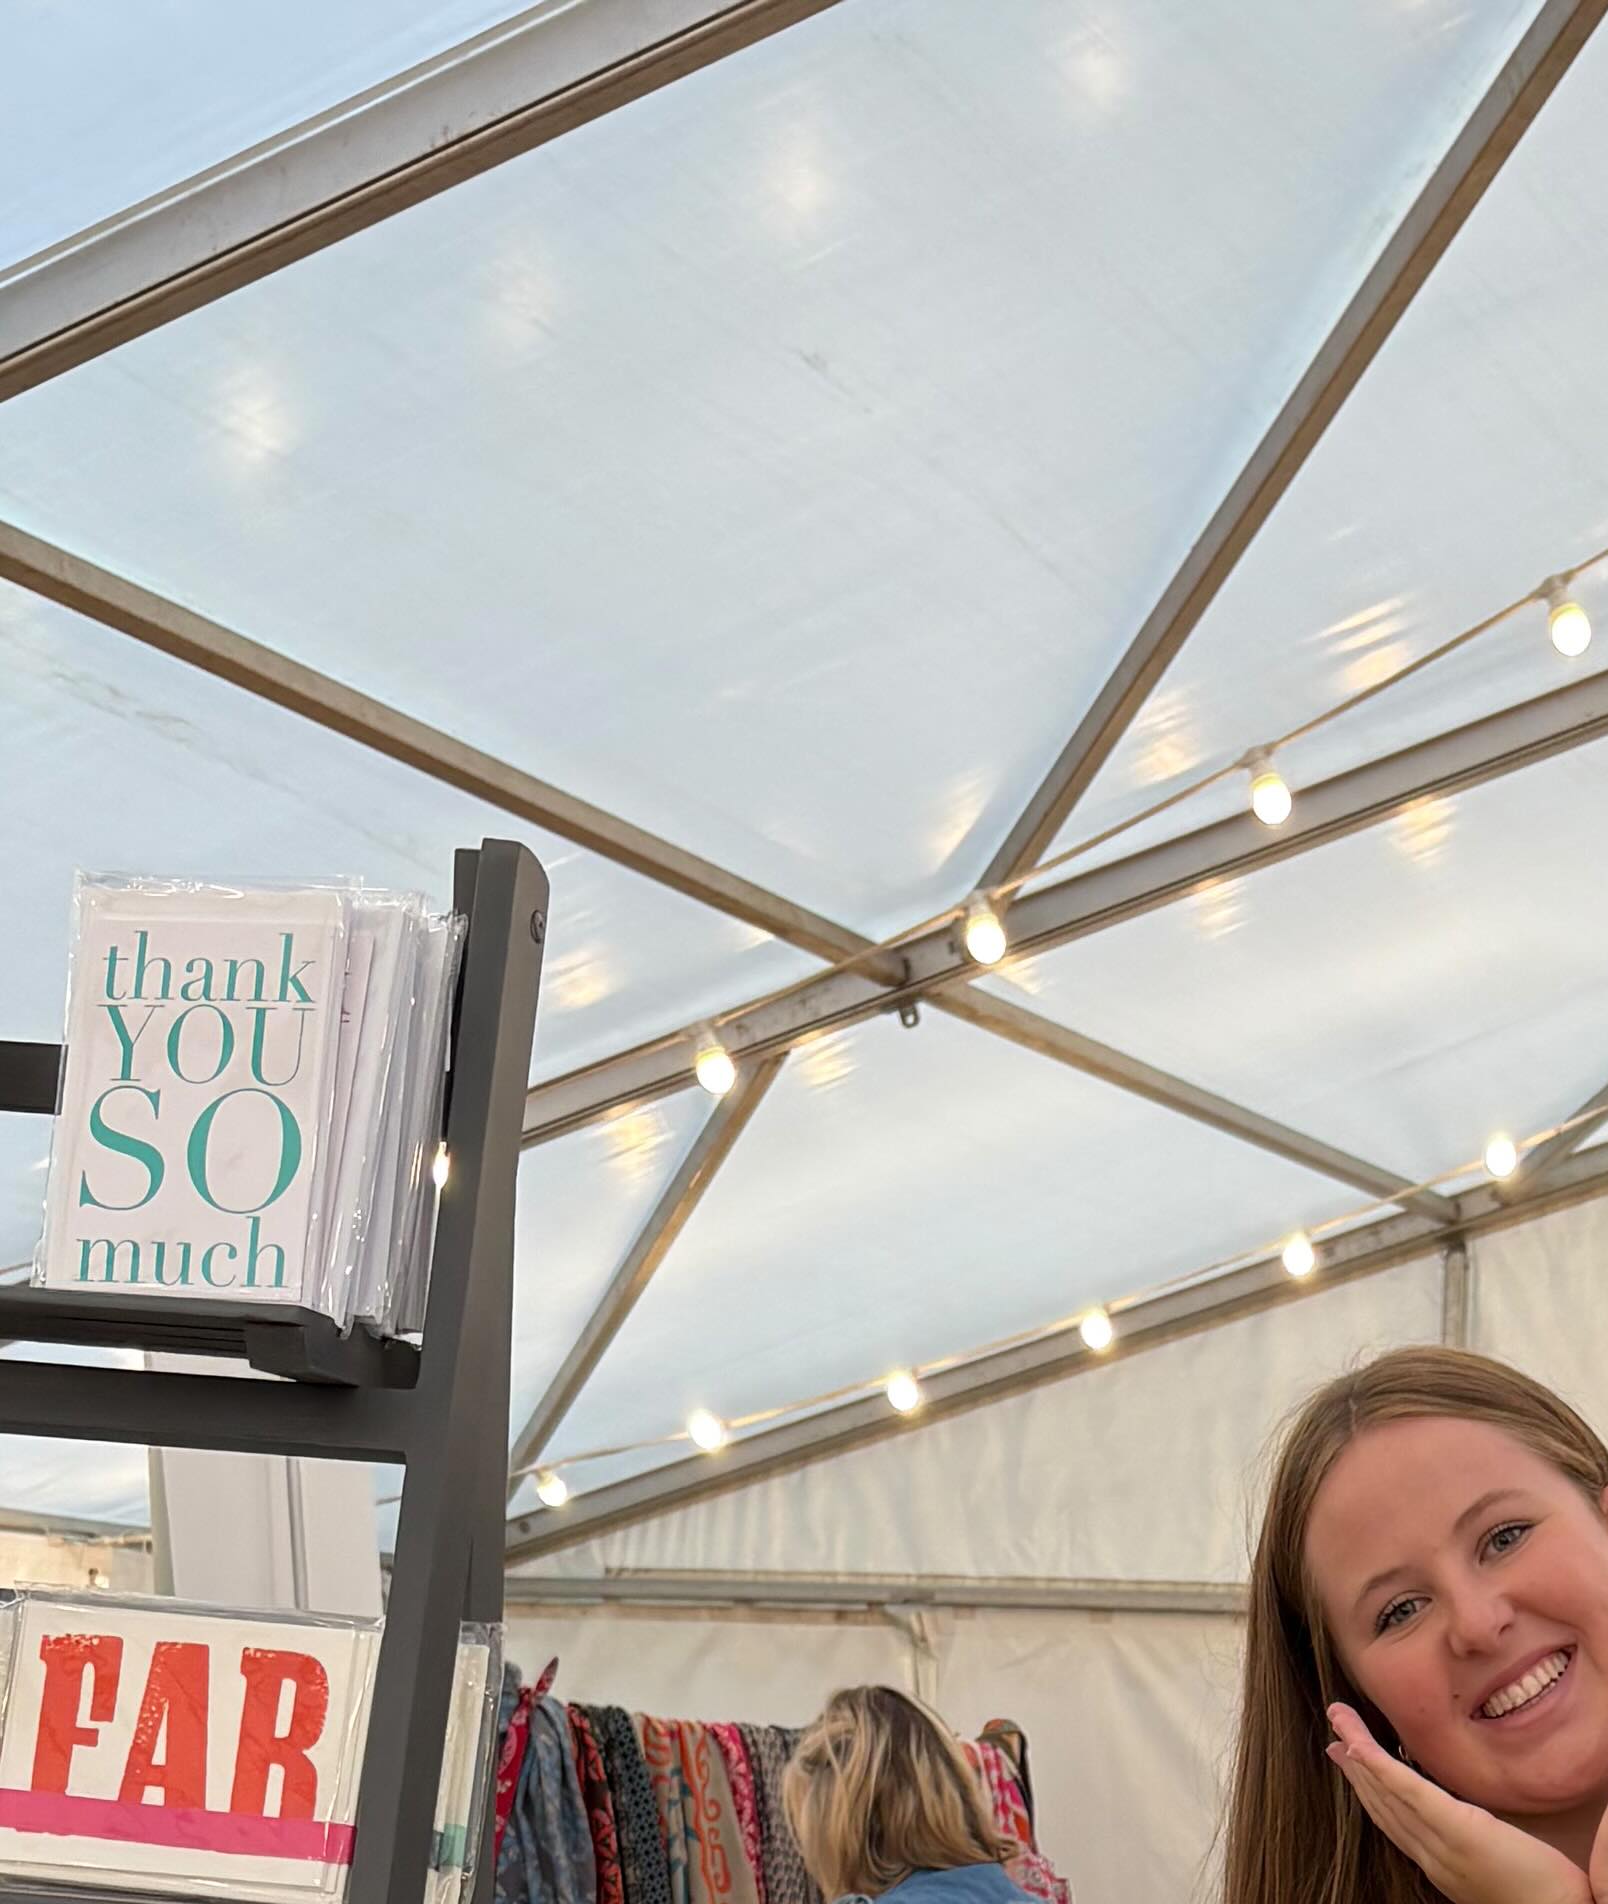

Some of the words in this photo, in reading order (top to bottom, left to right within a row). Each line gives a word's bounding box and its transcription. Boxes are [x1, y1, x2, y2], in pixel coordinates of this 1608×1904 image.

[102, 930, 317, 1003] thank
[97, 1003, 316, 1086] YOU
[79, 1085, 302, 1214] SO
[75, 1216, 289, 1288] much
[31, 1634, 329, 1822] FAR
